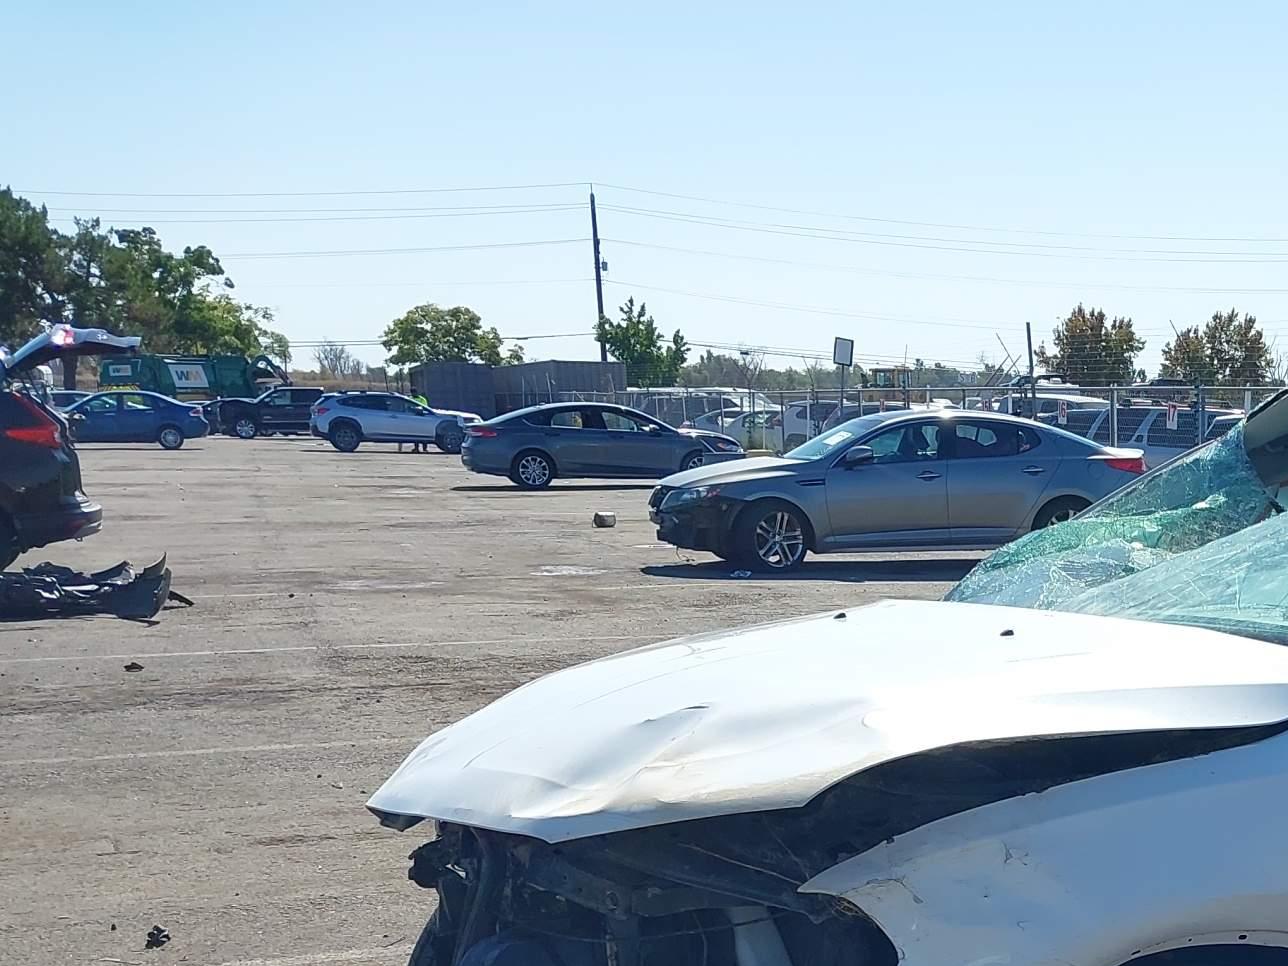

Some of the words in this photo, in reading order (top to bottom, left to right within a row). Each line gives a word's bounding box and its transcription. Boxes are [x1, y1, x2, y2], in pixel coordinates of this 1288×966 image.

[175, 370, 203, 382] WM
[1058, 401, 1067, 418] 16
[1168, 403, 1177, 422] 17
